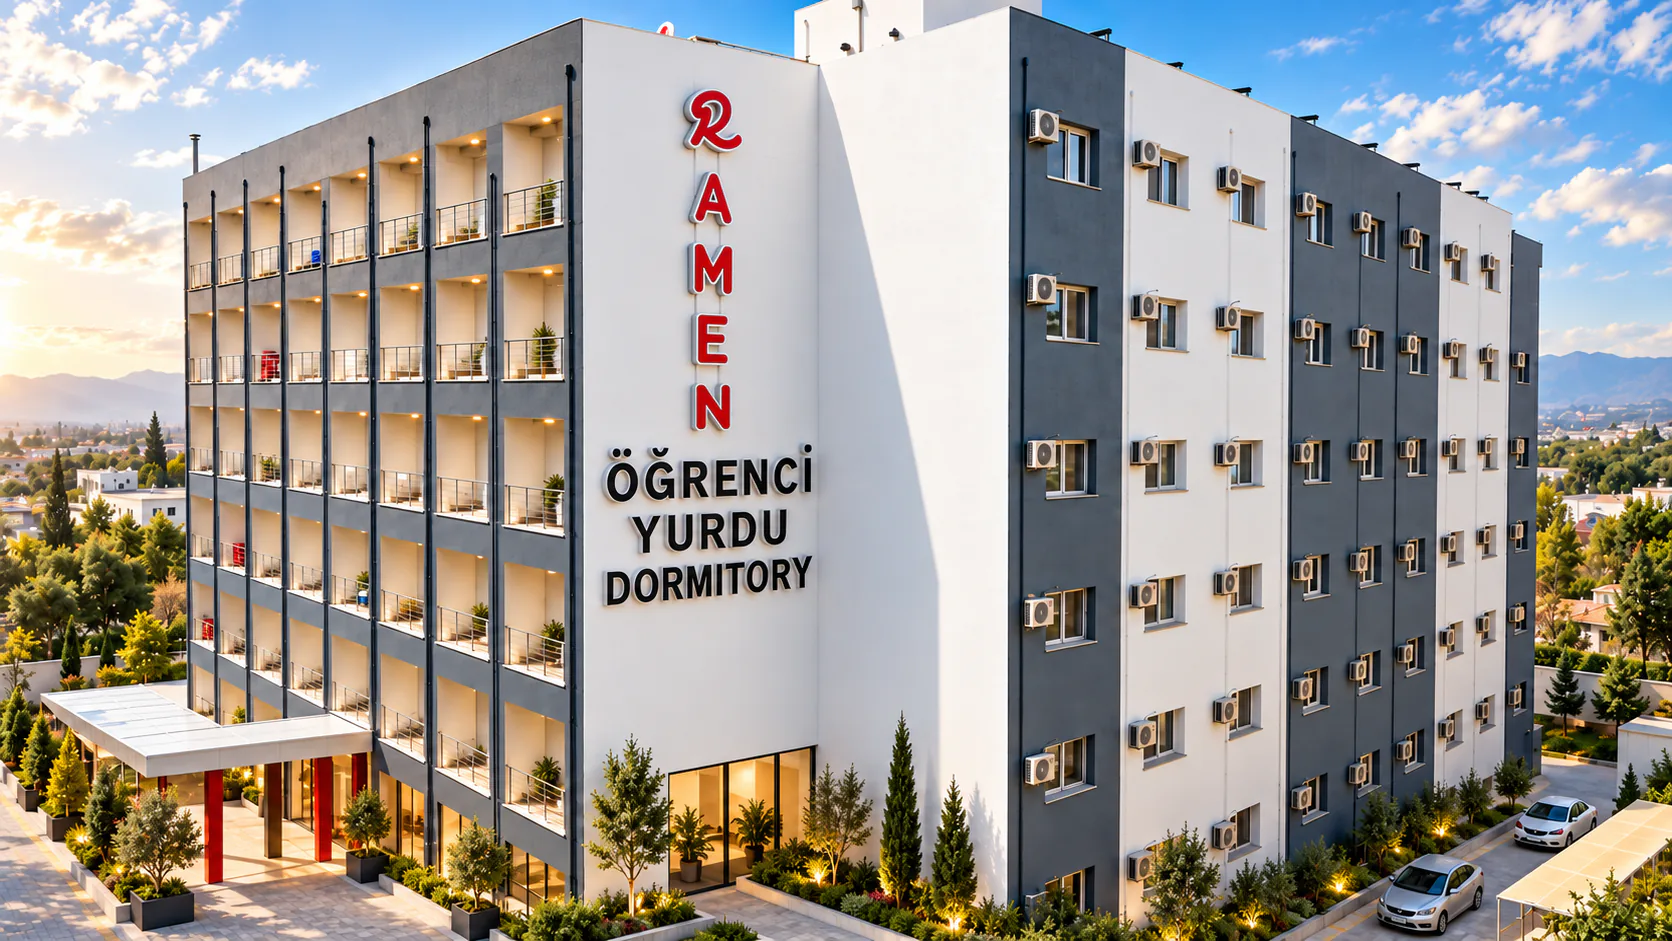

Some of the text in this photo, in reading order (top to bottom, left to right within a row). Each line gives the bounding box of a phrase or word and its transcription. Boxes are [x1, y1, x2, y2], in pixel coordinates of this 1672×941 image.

[685, 88, 743, 431] RAMEN
[606, 444, 813, 503] ÖĞRENCİ
[631, 508, 788, 554] YURDU
[605, 555, 813, 606] DORMITORY
